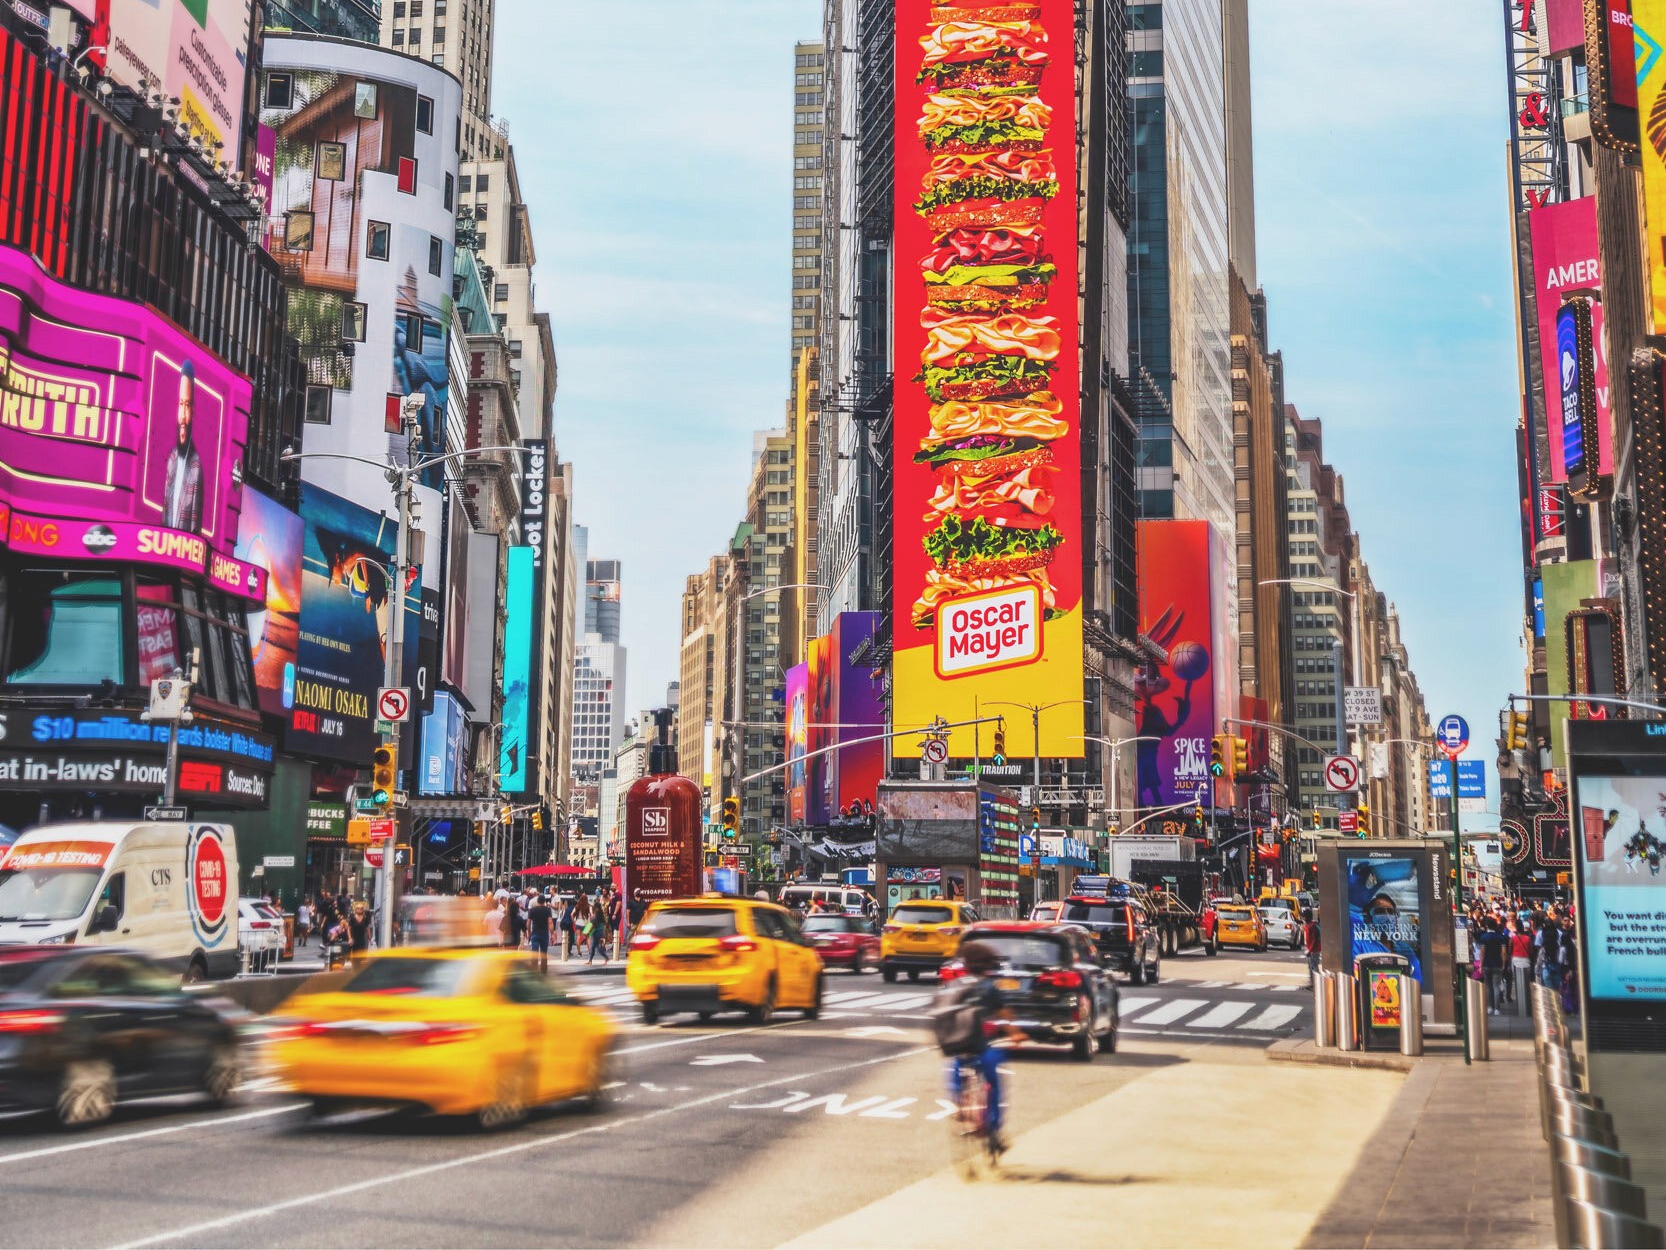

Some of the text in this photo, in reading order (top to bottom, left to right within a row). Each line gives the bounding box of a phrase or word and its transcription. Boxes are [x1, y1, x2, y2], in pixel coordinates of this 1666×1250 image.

[16, 3, 49, 30] OUTFRO
[191, 28, 227, 92] Customizable
[179, 45, 232, 130] prescription glasses
[1562, 392, 1578, 411] TACO
[1564, 407, 1579, 426] BELL
[137, 529, 203, 565] SUMMER
[214, 557, 241, 587] GAMES
[952, 600, 1026, 632] Oscar
[949, 624, 1029, 659] Mayer
[295, 679, 332, 710] NAOMI
[335, 689, 369, 719] OSAKA
[153, 725, 203, 747] reards
[321, 718, 337, 735] JULY
[336, 721, 343, 737] 16
[1646, 723, 1666, 735] Lin
[1174, 738, 1205, 754] SPACE
[24, 758, 121, 781] in-laws'
[1174, 754, 1208, 776] JAM
[1174, 781, 1195, 789] JULY
[363, 799, 372, 808] 44
[307, 808, 345, 819] BUCKS
[644, 811, 667, 827] Sb
[630, 841, 659, 849] COCONUT
[56, 851, 102, 865] TESTING
[151, 868, 171, 886] CTS
[199, 860, 221, 878] COVID-19
[201, 880, 221, 898] TESTING
[1604, 910, 1666, 921] You want di
[1353, 932, 1418, 941] NEW YORK
[1609, 923, 1628, 932] but
[1630, 923, 1648, 932] the
[1607, 946, 1644, 956] French
